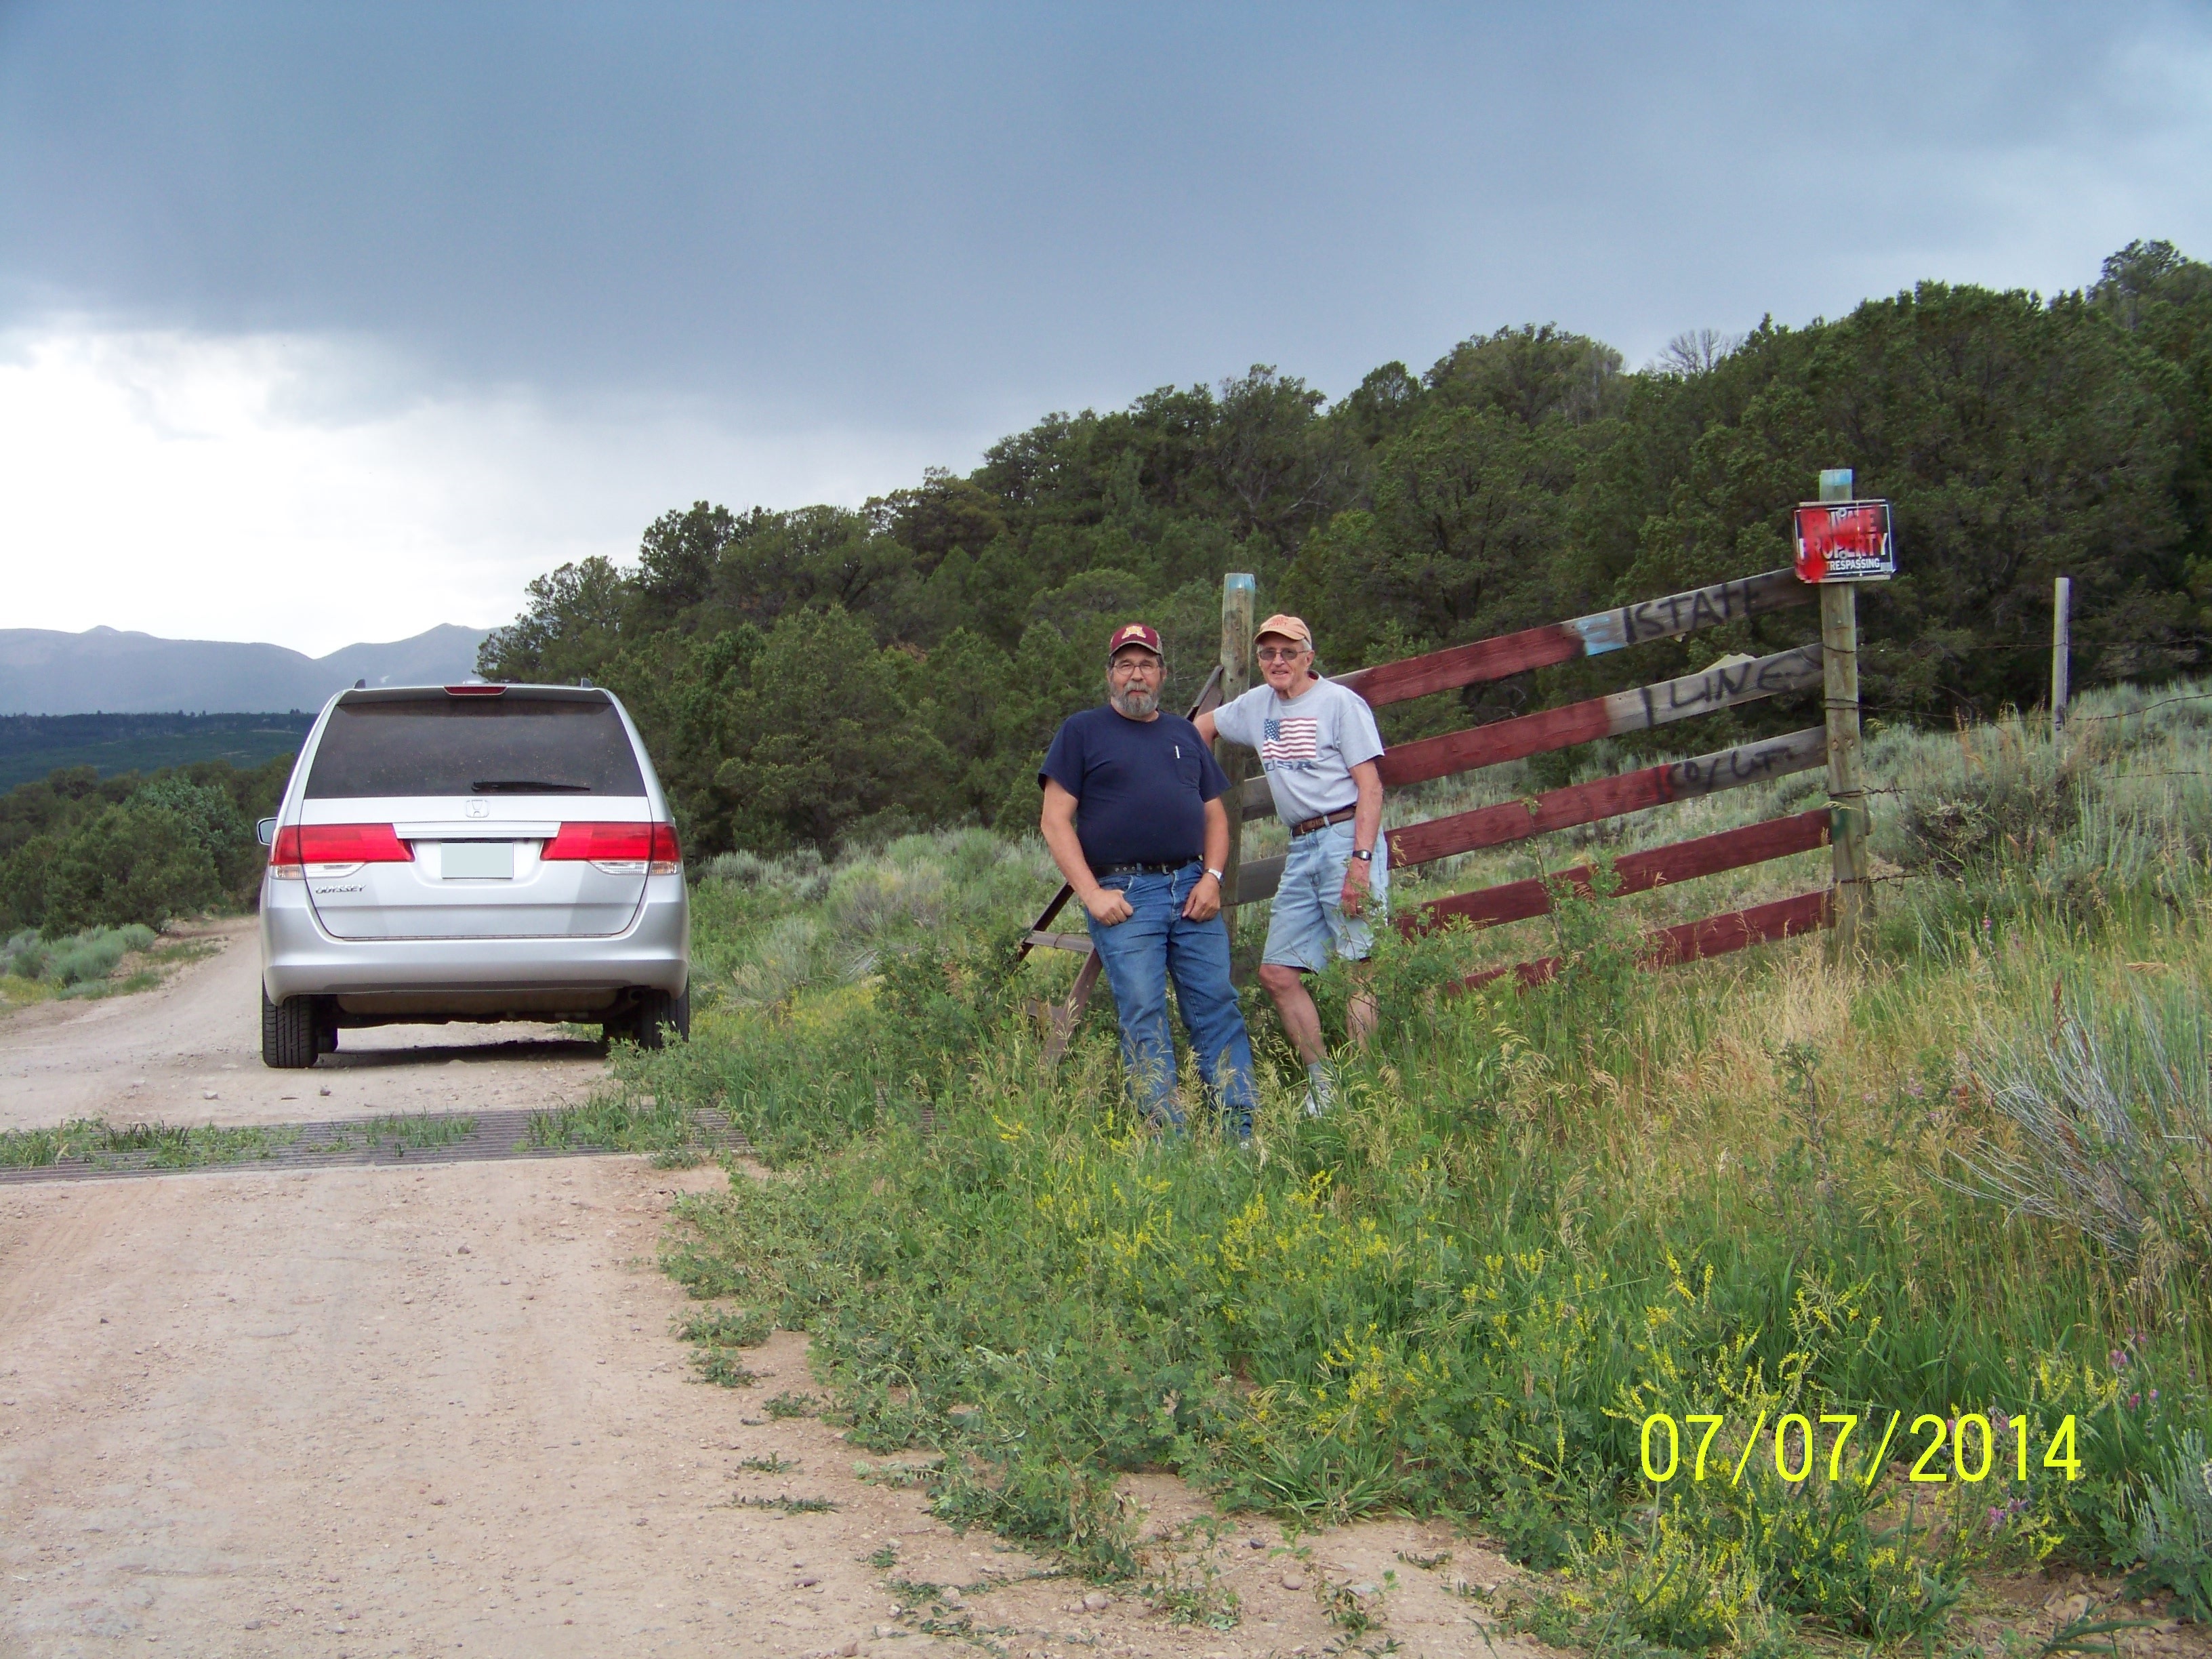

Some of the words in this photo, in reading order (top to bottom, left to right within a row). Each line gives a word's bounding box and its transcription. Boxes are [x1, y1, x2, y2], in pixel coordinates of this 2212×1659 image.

[1826, 558, 1880, 571] TRESPASSING
[1264, 760, 1318, 771] USA
[316, 884, 366, 894] ODYSSEY
